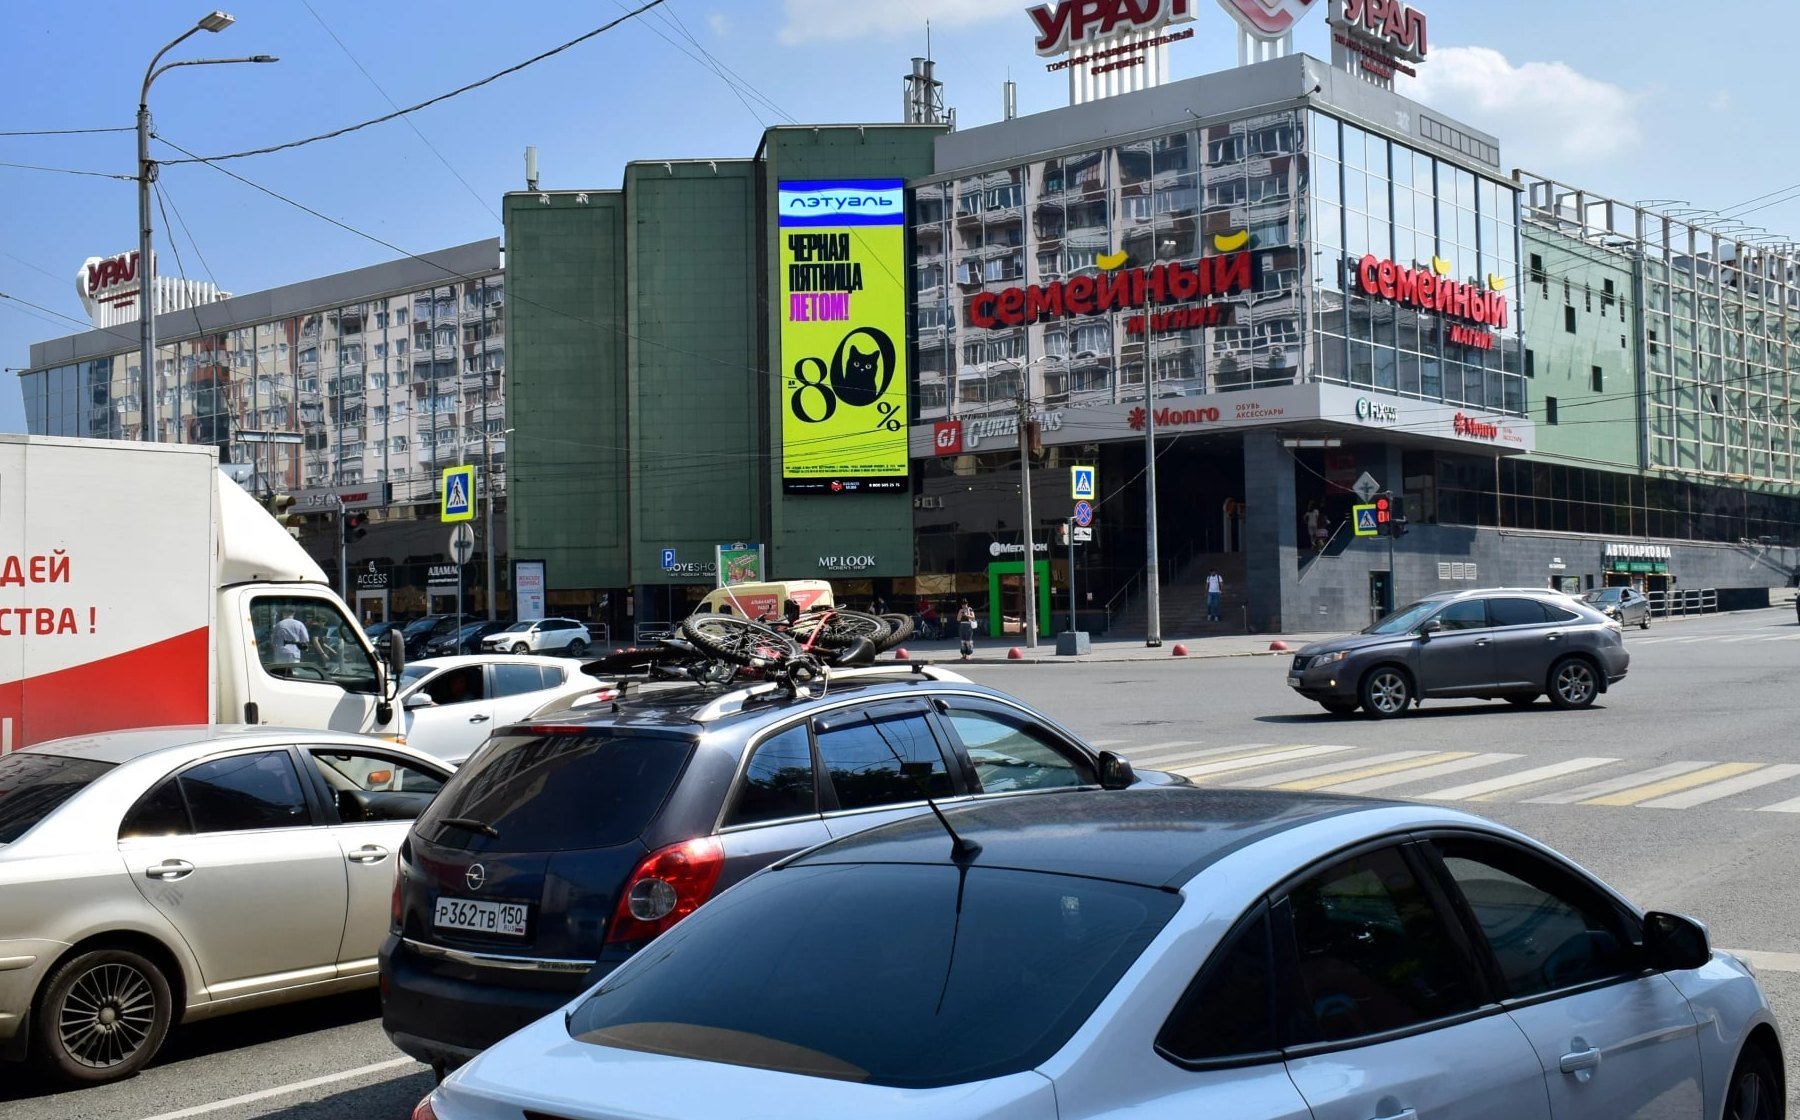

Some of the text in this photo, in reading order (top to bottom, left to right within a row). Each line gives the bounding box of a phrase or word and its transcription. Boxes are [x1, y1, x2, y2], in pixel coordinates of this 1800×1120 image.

[788, 233, 850, 262] ЧЕРНАЯ
[789, 263, 863, 294] ПЯТНИЦА
[789, 292, 850, 322] ЛЕТОМ!
[1236, 402, 1260, 410] ОБУВЬ
[1236, 408, 1284, 418] АКСЕССУАРЫ
[819, 555, 876, 567] MP LOOK
[1606, 544, 1672, 558] АВТОПАРКОВКА
[439, 902, 522, 928] Р362ТВ 150
